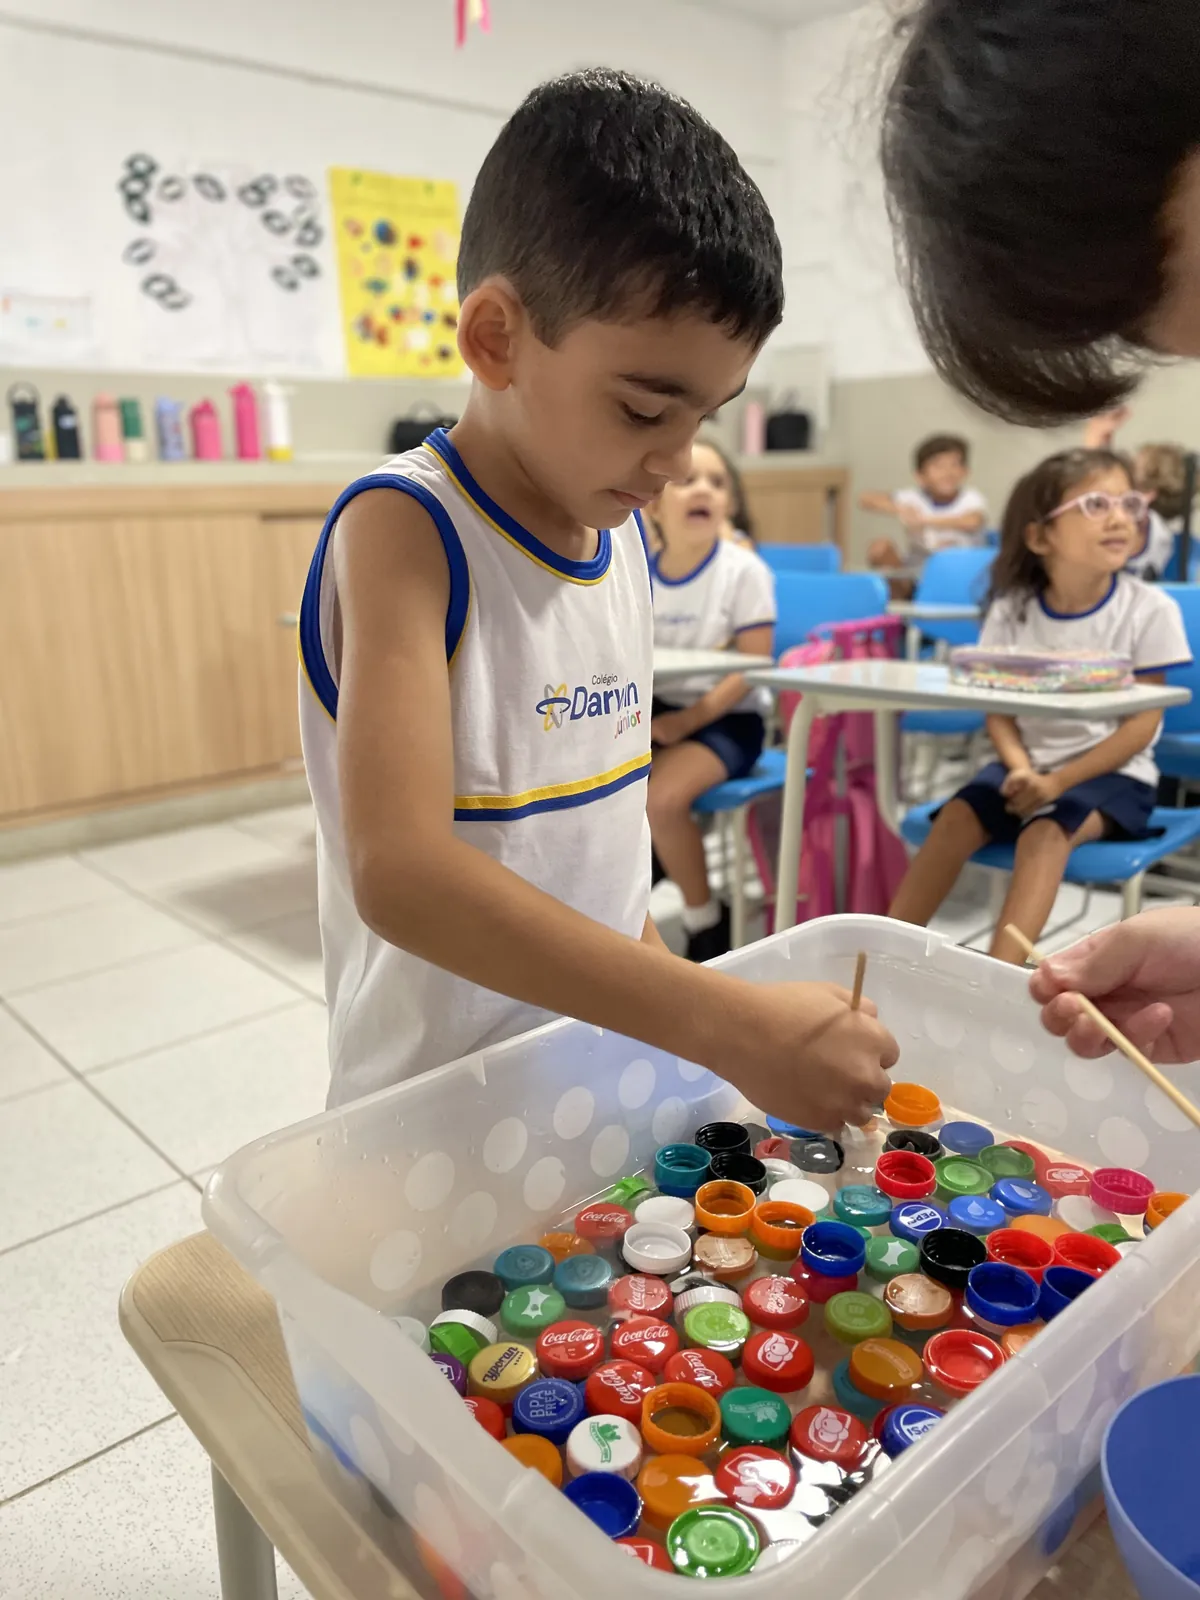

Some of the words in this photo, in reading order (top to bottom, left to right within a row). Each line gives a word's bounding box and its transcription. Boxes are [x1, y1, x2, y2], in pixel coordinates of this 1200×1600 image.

[591, 673, 618, 686] Colégio
[529, 1390, 545, 1418] BPA
[545, 1389, 557, 1417] FREE
